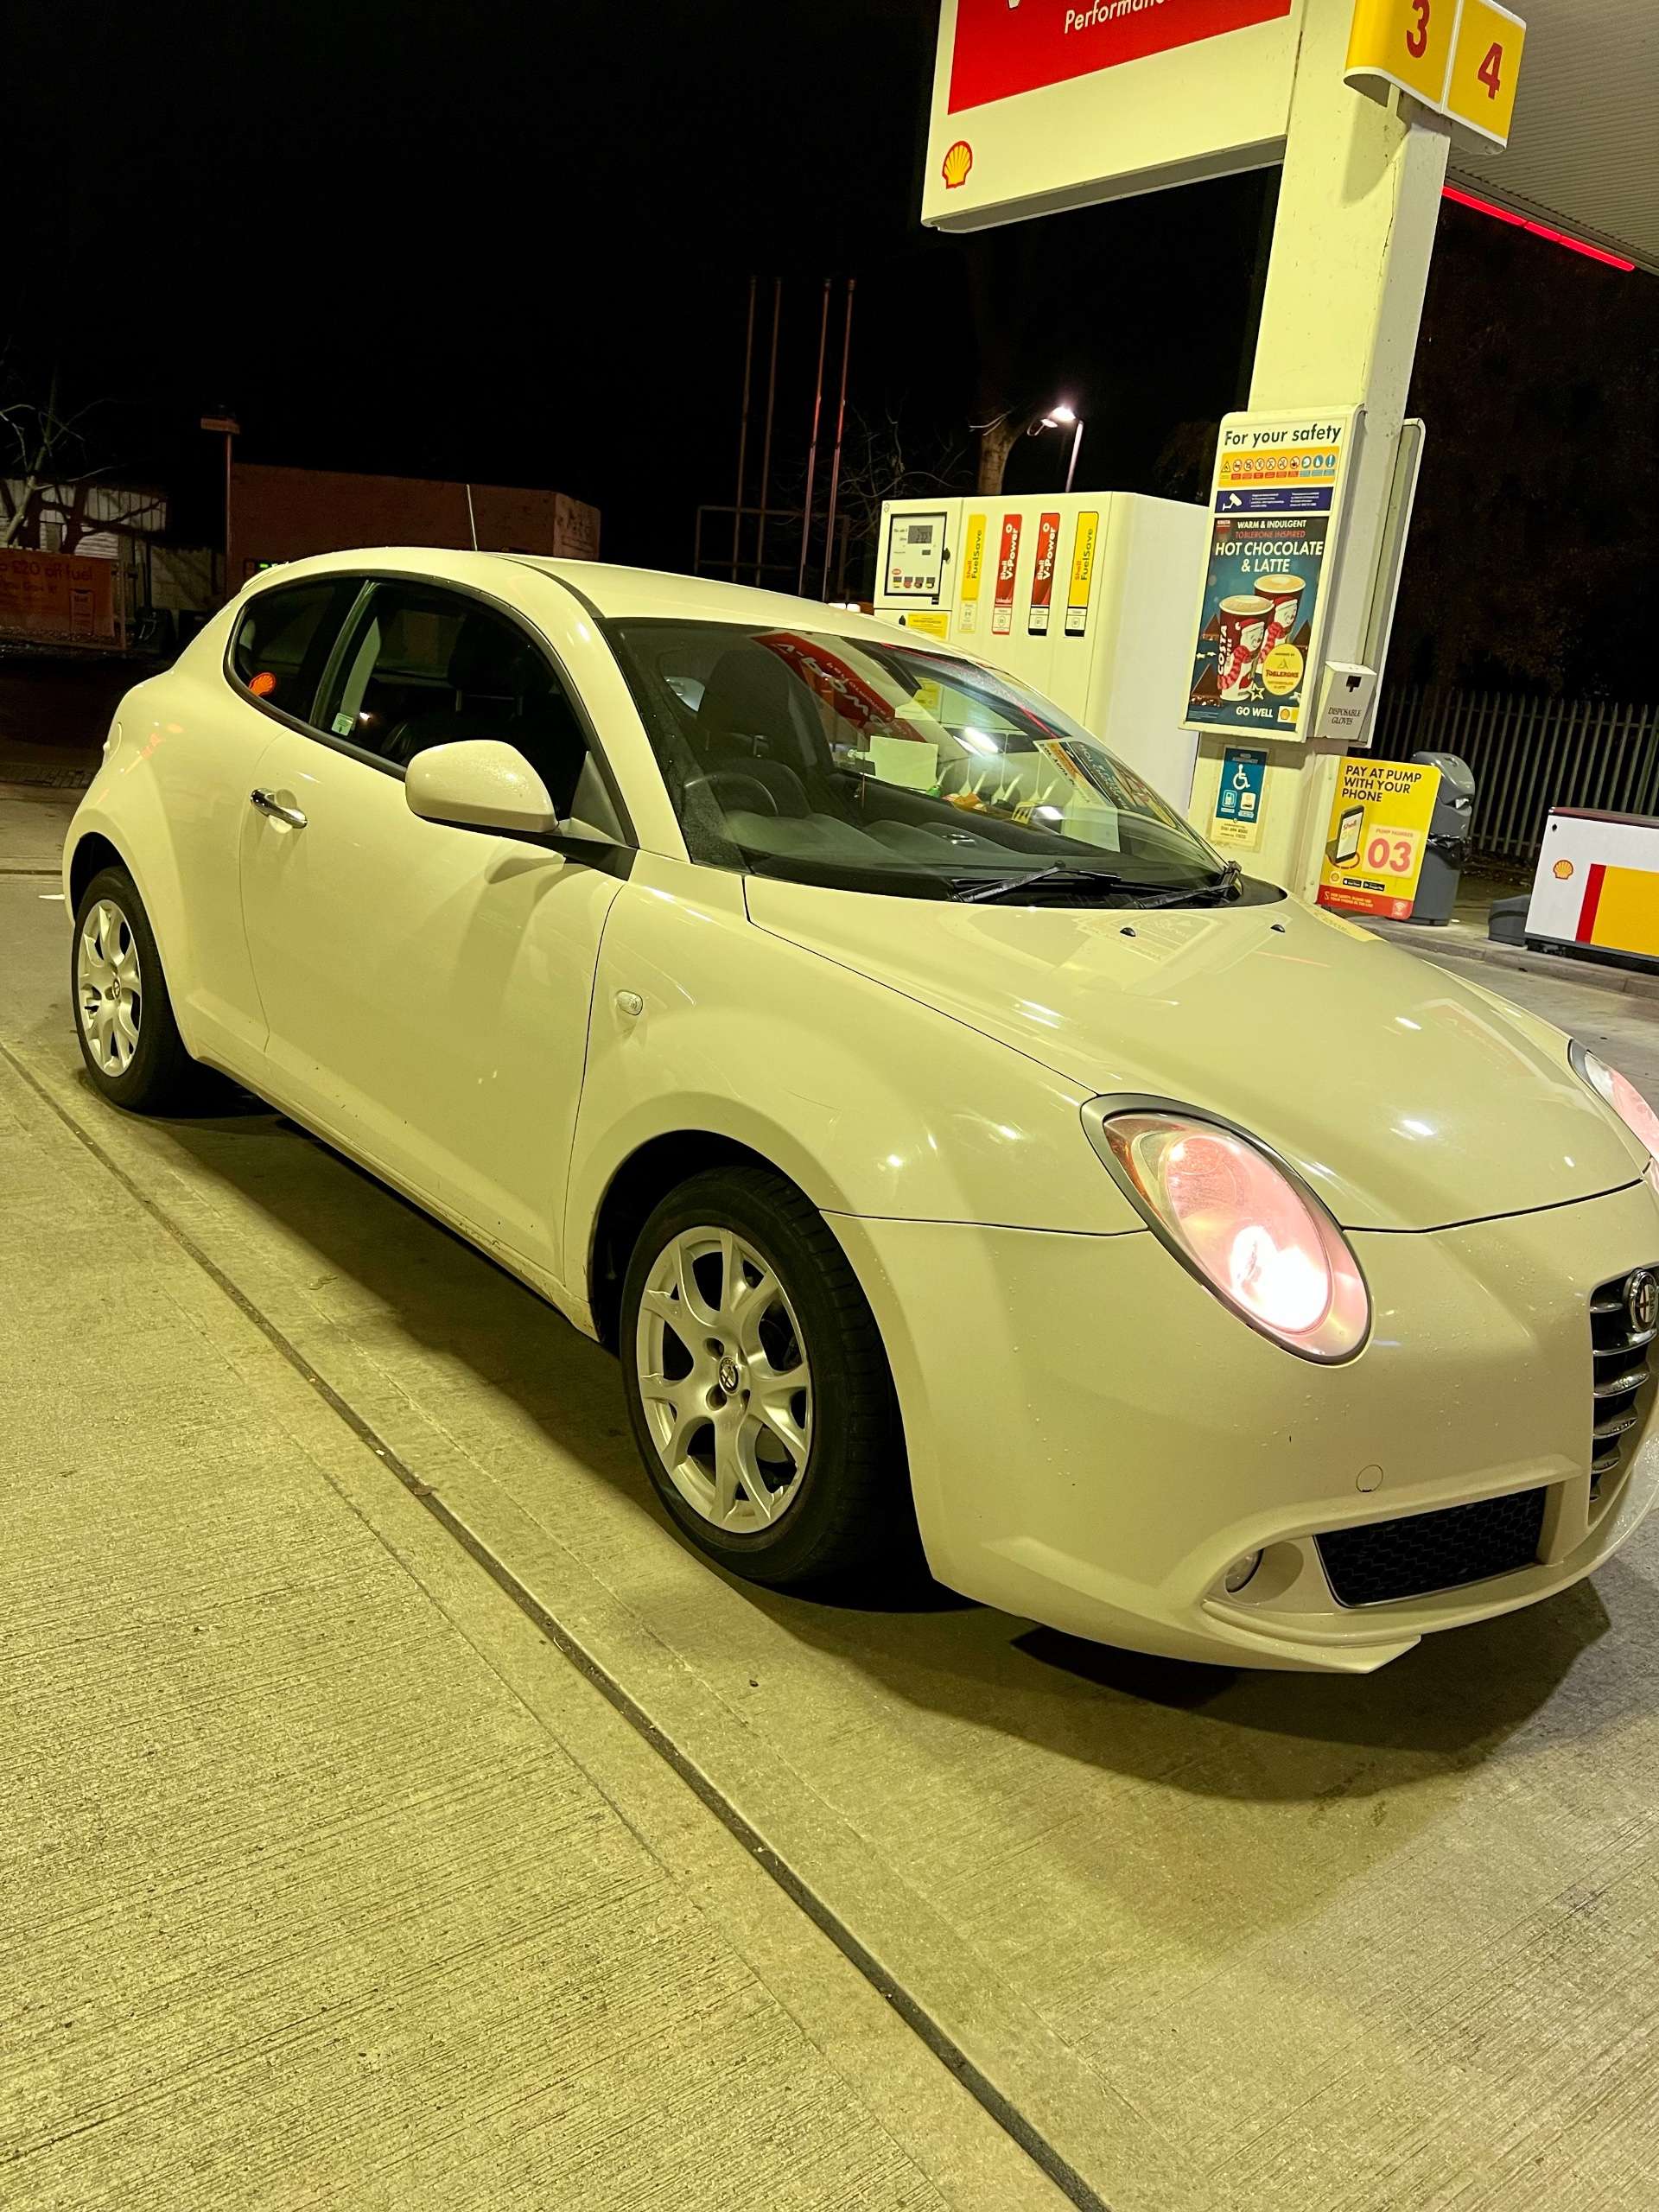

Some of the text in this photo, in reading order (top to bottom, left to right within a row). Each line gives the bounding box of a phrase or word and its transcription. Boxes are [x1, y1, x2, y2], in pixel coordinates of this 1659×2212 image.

[1064, 0, 1165, 35] Performan
[1406, 0, 1430, 59] 3
[1477, 41, 1503, 100] 4
[1224, 423, 1341, 448] For your safety
[1236, 530, 1306, 539] TOBLERONE INSPIRED
[1237, 520, 1259, 529] WARM
[1267, 519, 1307, 528] INDULGENT
[971, 529, 982, 579] FuelSave
[1005, 528, 1019, 580] V-Power
[1042, 527, 1056, 580] V-Power
[1081, 528, 1094, 581] FuelSave
[1215, 541, 1324, 556] HOT CHOCOLATE
[1000, 560, 1008, 581] Shell
[1241, 558, 1291, 572] & LATTE
[1218, 625, 1227, 675] COSTA
[1236, 706, 1274, 718] GO WELL
[1344, 776, 1411, 794] WITH YOUR
[1345, 765, 1421, 783] PAY AT PUMP
[1342, 788, 1382, 802] PHONE
[1368, 837, 1412, 873] 03
